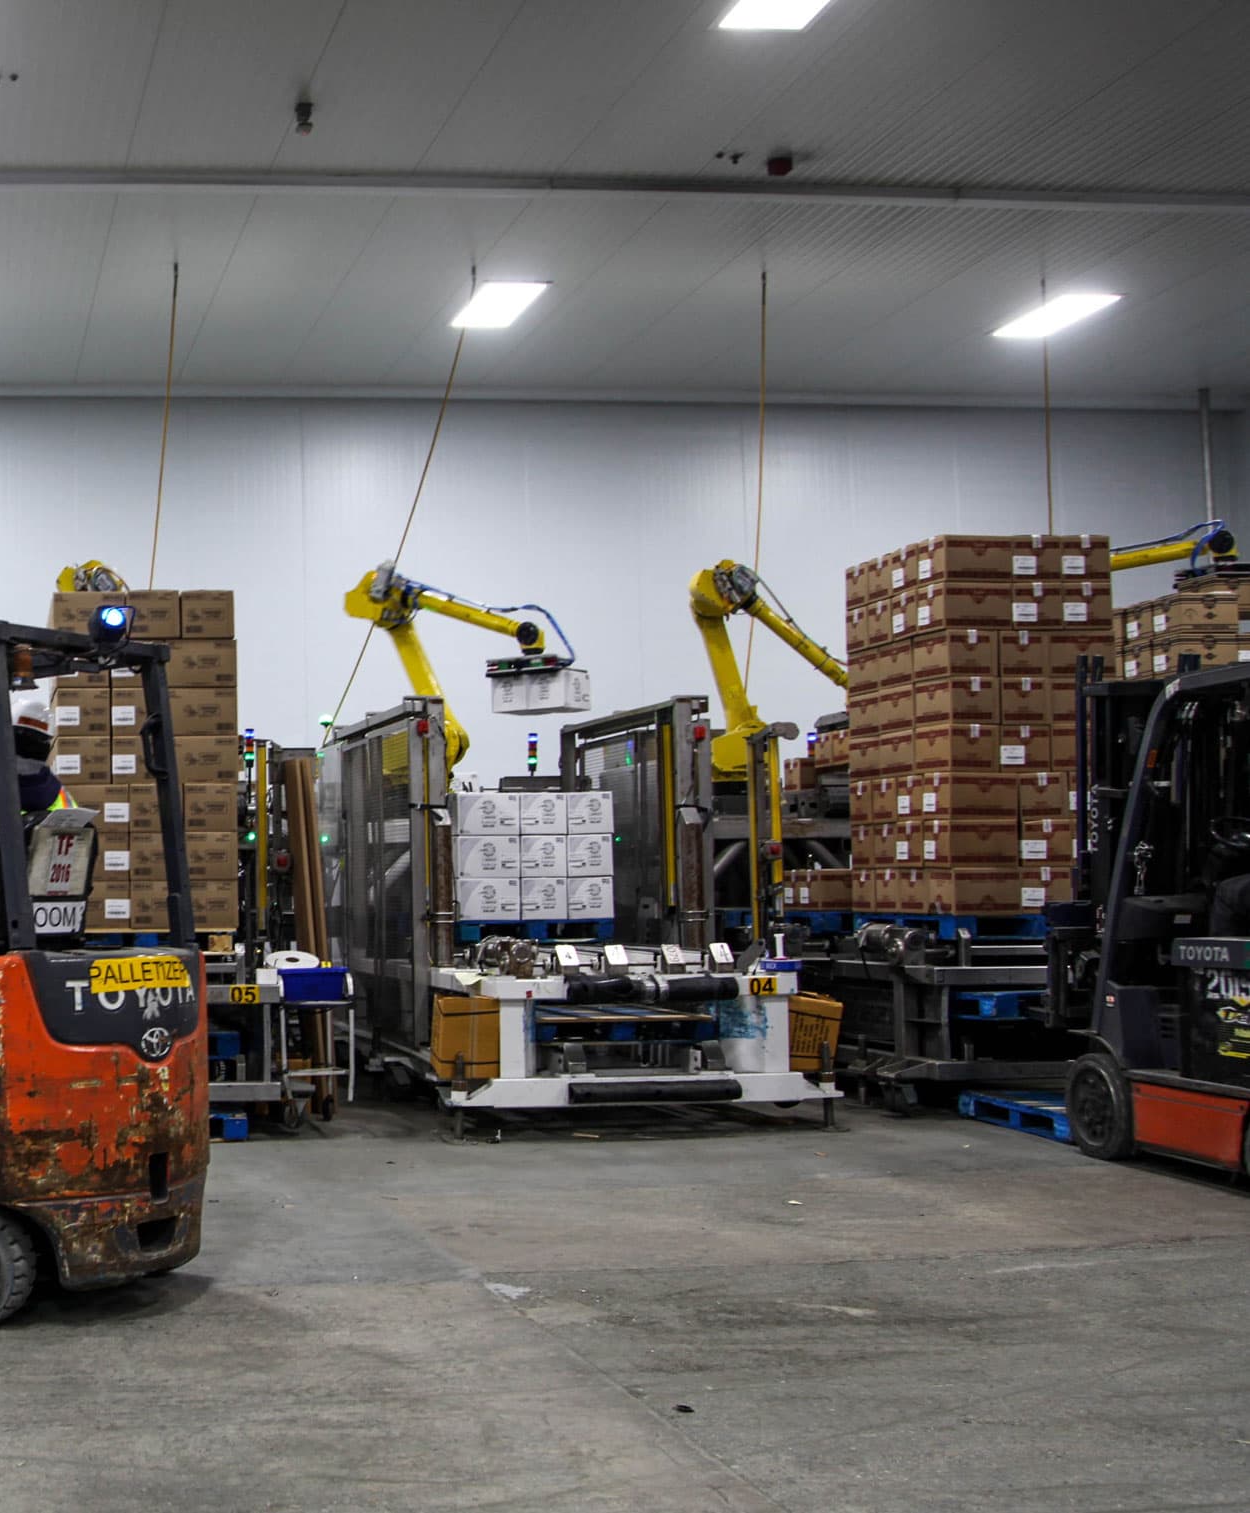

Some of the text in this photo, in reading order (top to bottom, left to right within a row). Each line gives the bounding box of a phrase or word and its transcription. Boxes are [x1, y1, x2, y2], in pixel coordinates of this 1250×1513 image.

[57, 834, 74, 856] TF
[1179, 946, 1230, 961] TOYOTA
[231, 986, 256, 1004] 05
[750, 977, 775, 995] 04
